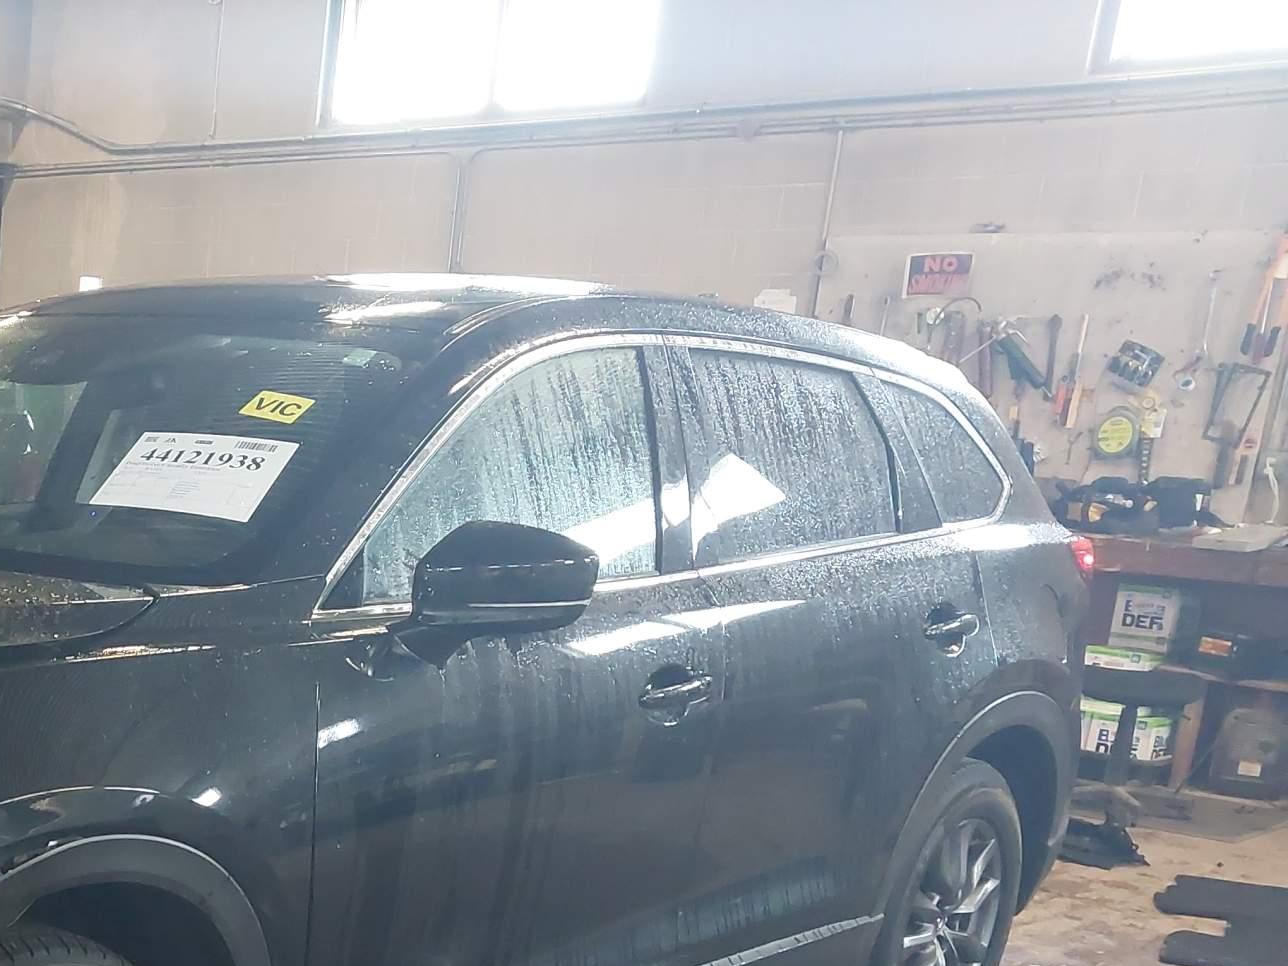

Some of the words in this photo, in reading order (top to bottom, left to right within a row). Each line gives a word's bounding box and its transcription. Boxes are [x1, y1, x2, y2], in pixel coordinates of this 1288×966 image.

[923, 255, 959, 273] NO
[255, 397, 302, 417] VIC
[140, 447, 266, 472] 44121938
